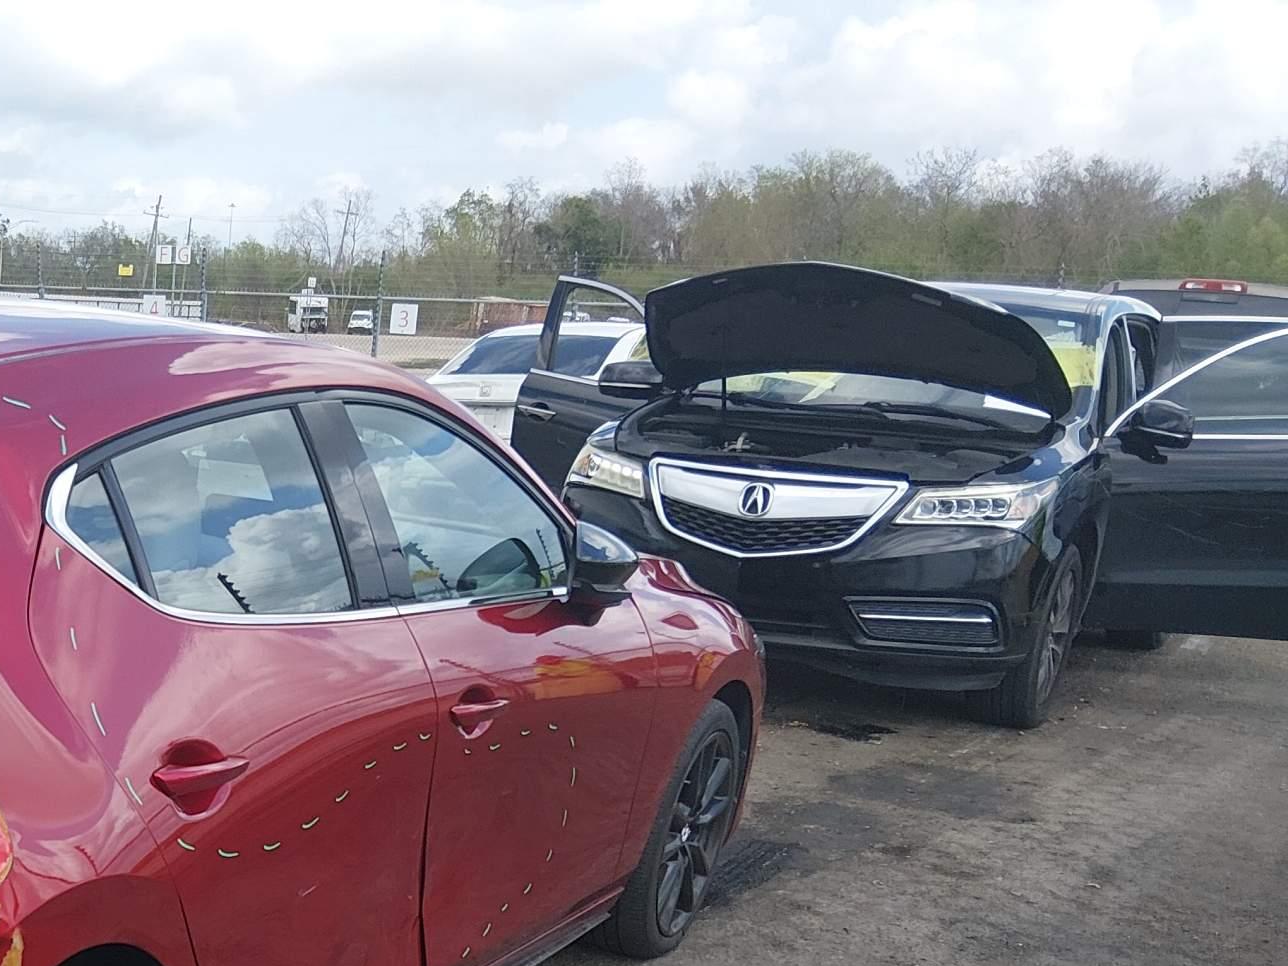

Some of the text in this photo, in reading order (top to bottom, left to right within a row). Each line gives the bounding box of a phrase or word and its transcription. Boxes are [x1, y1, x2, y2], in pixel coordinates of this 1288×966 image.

[160, 246, 168, 262] F
[177, 246, 189, 263] G
[398, 310, 409, 328] 3
